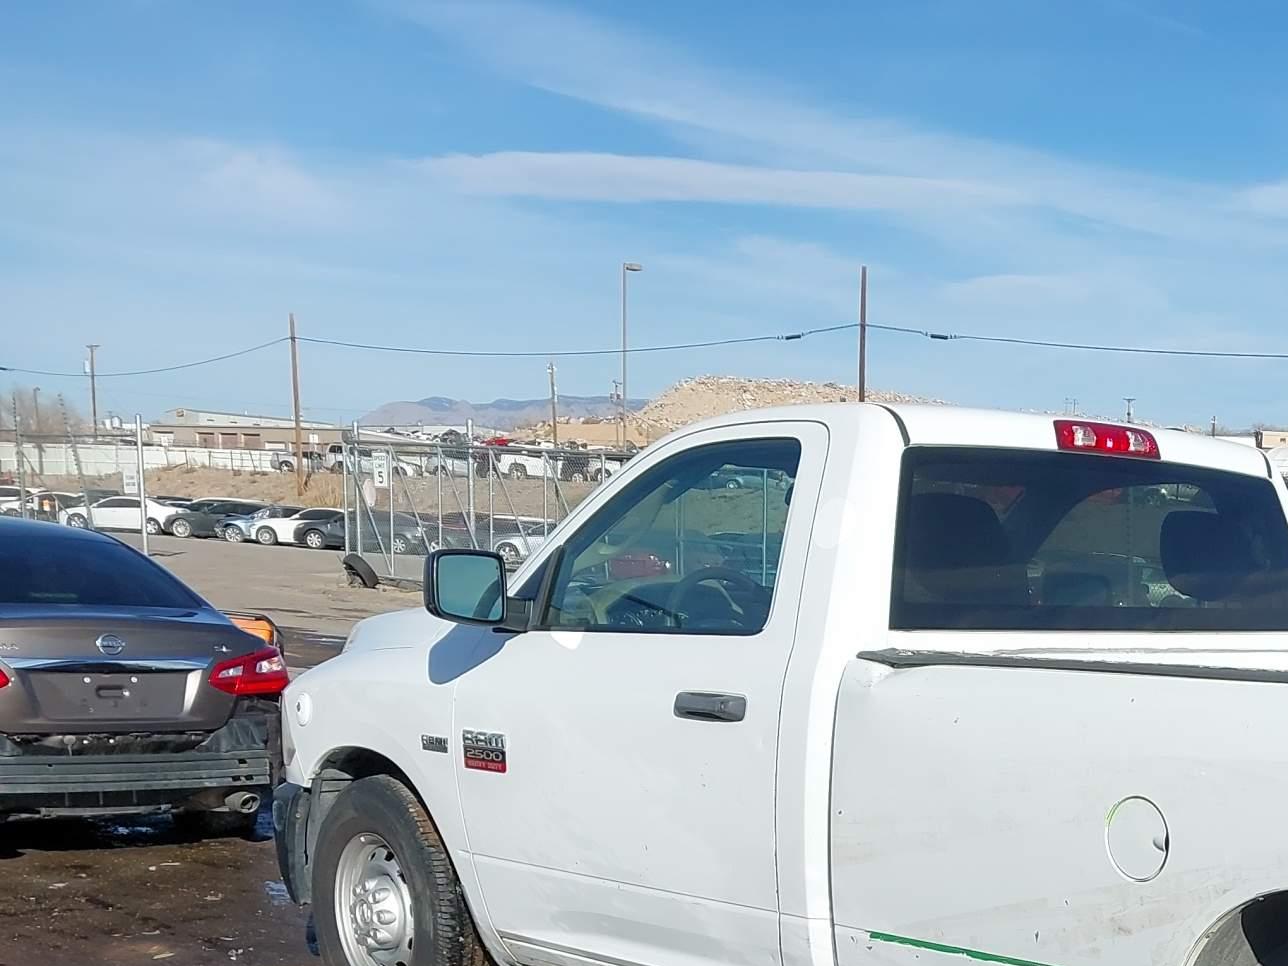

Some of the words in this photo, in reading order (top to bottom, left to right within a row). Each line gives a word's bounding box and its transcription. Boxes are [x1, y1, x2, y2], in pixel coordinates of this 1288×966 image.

[378, 471, 384, 484] 5
[463, 729, 506, 750] RAM
[466, 748, 503, 762] 2500
